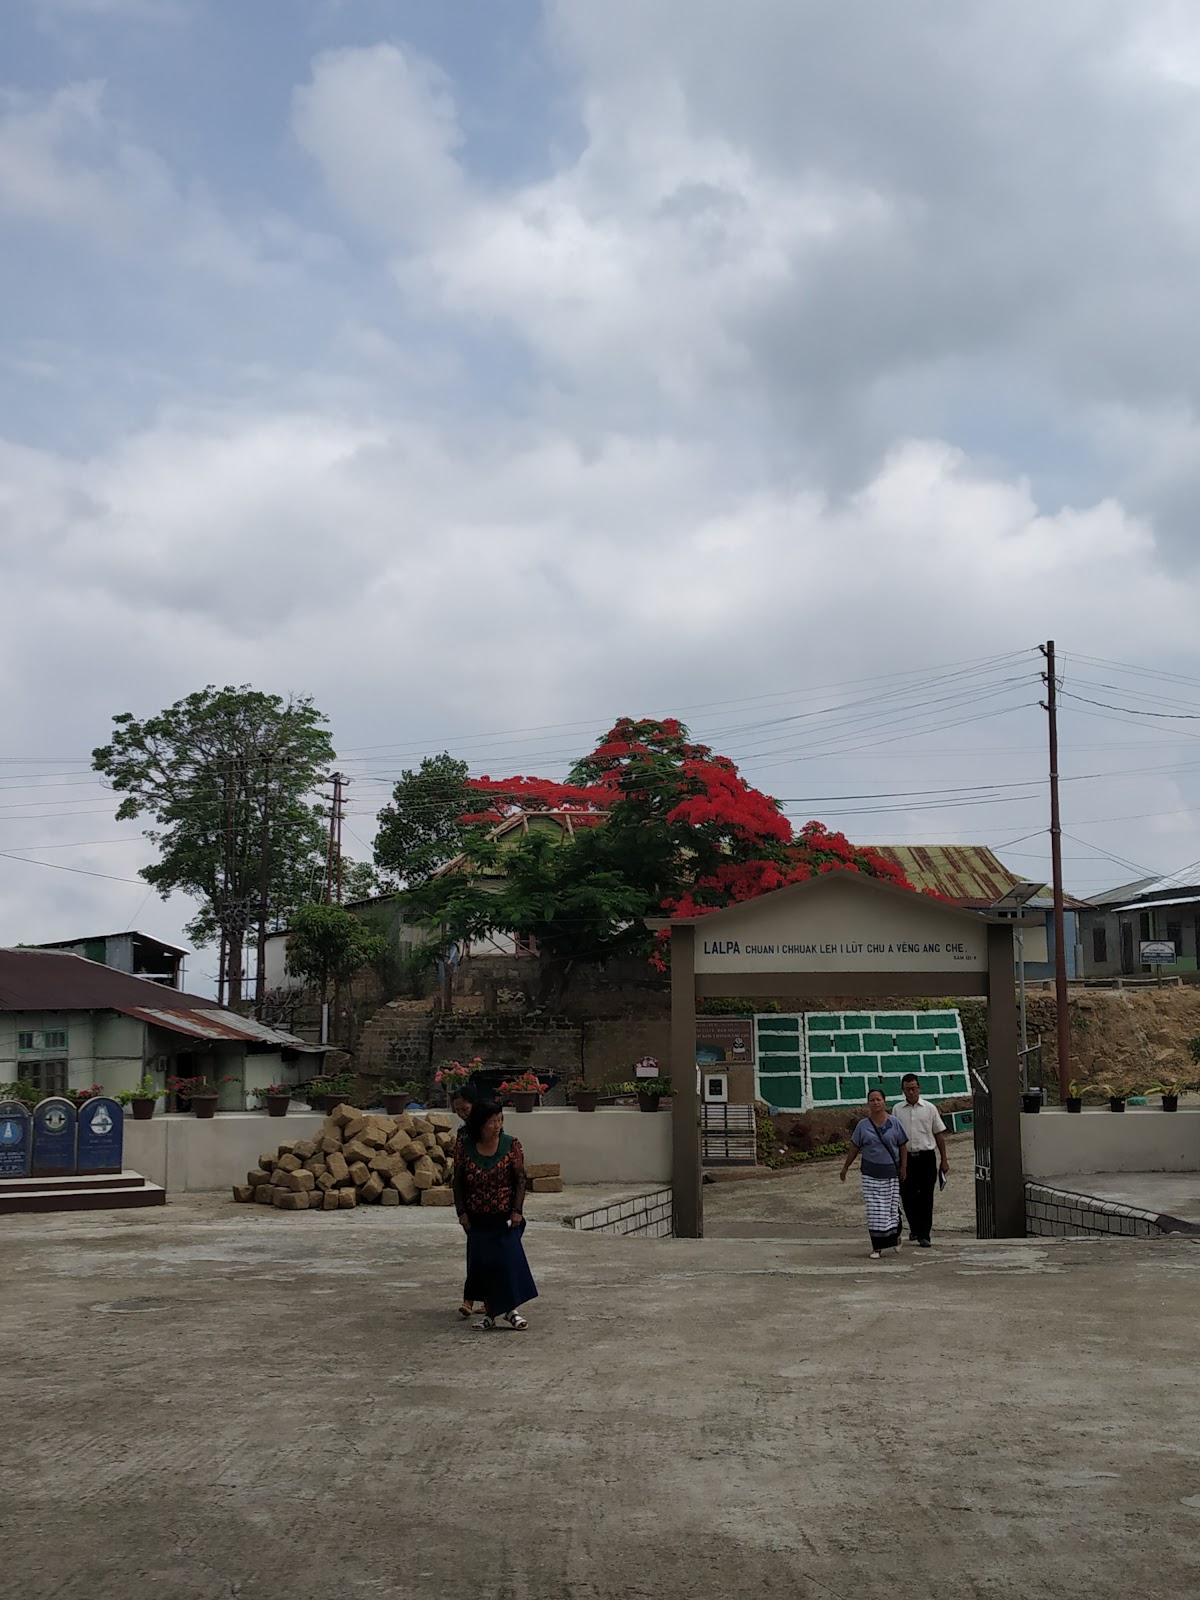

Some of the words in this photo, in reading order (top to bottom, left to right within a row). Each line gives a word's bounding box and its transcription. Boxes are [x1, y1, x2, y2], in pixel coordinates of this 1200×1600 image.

[704, 941, 740, 954] LALPA
[745, 945, 774, 954] CHUAN
[782, 944, 817, 954] CHHUAK
[820, 944, 838, 953] LEH
[867, 943, 885, 953] CHU
[888, 944, 895, 953] A
[923, 943, 940, 953] ANG
[945, 943, 968, 953] CHE.
